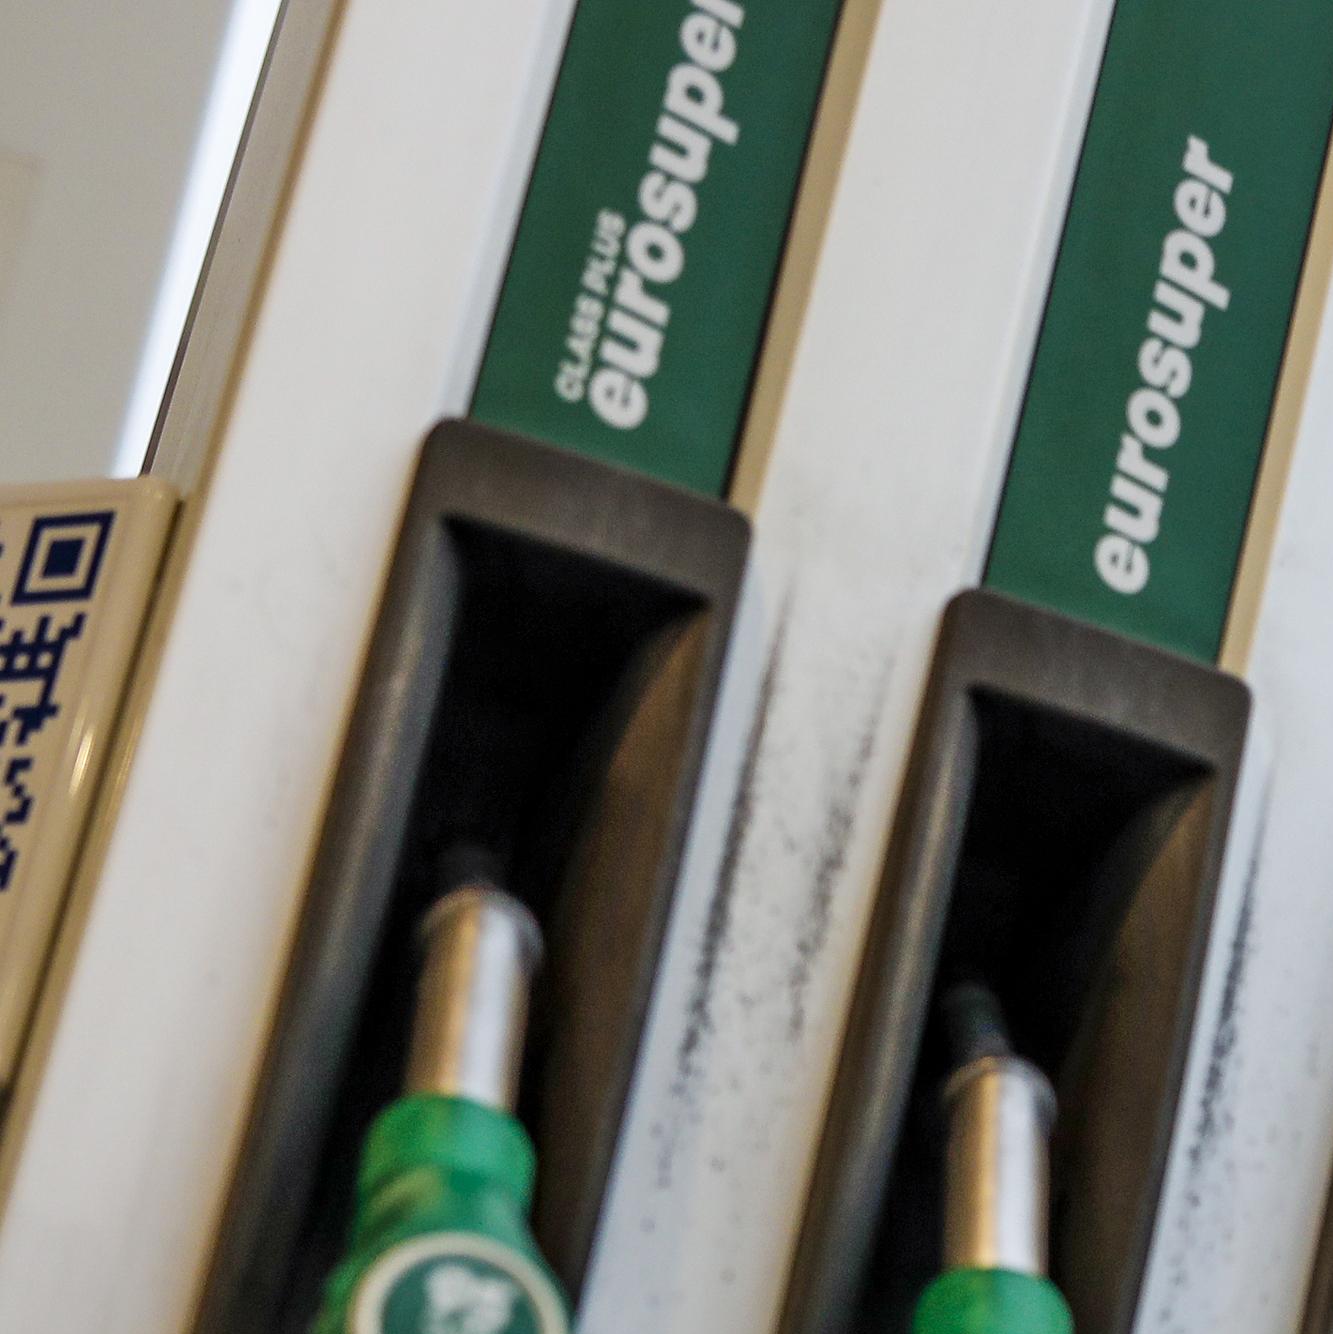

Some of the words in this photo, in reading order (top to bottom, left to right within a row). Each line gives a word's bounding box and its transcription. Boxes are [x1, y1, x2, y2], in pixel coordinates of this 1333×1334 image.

[554, 293, 604, 402] CLASS
[581, 208, 627, 294] PLUS
[1094, 134, 1233, 594] eurosuper
